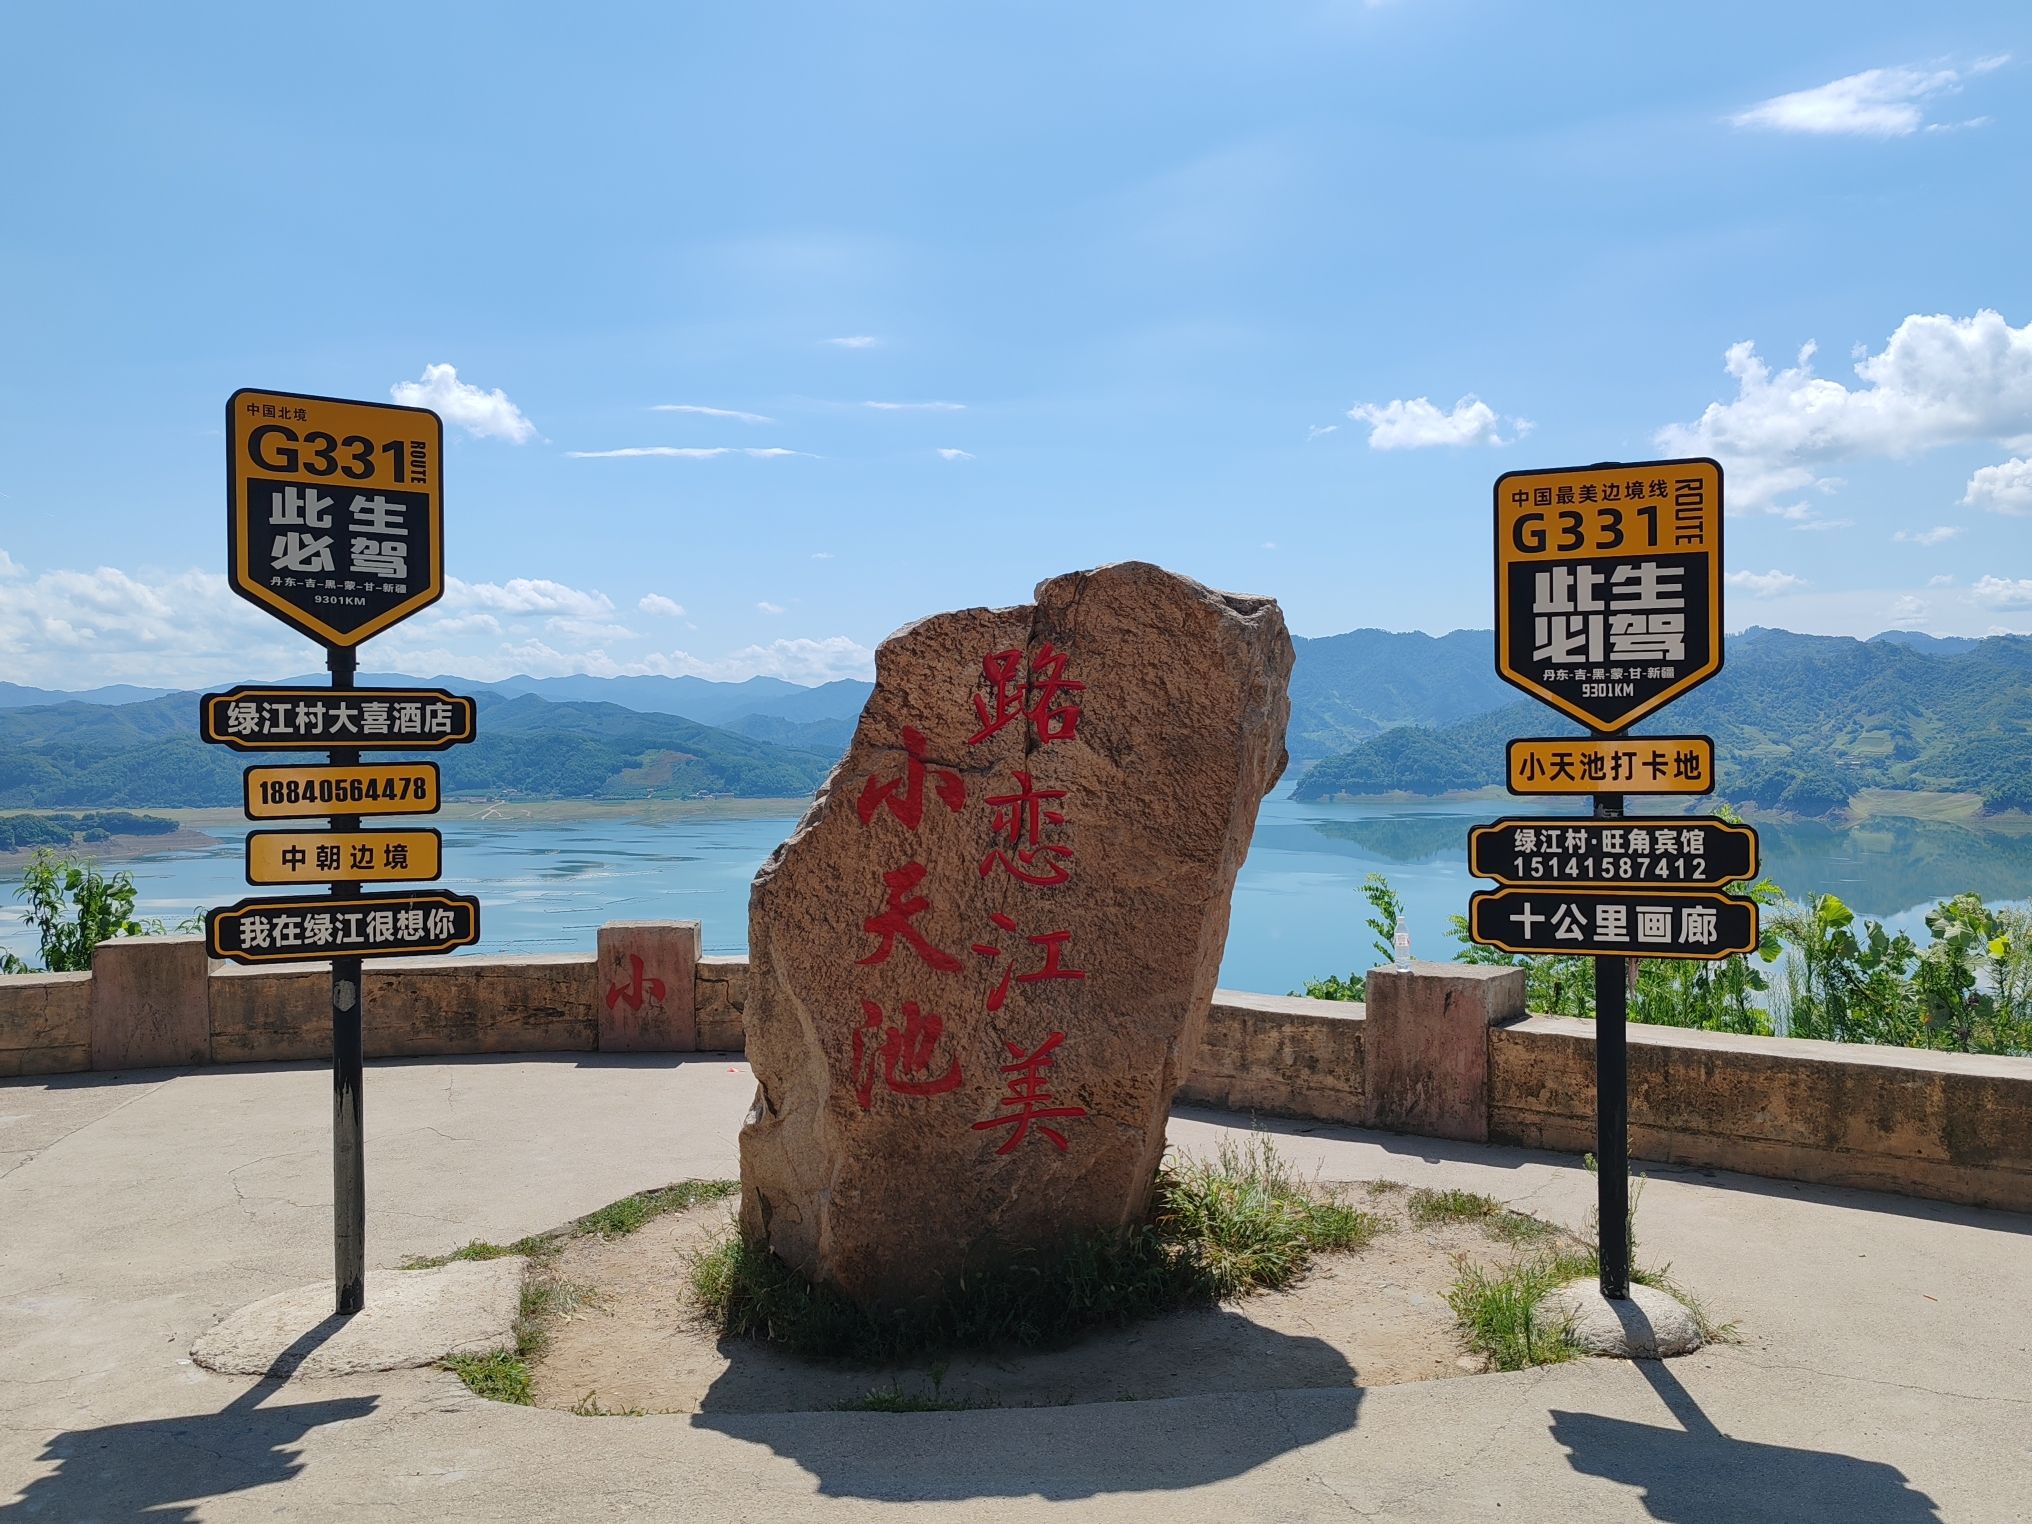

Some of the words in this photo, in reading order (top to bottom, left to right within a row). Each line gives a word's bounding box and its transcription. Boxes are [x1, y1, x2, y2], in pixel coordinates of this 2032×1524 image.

[247, 403, 307, 421] 中国北境
[247, 425, 405, 483] G331
[410, 441, 426, 484] ROUTE
[269, 486, 408, 535] 此生
[1512, 479, 1668, 508] 中国最美边境线
[1675, 478, 1703, 545] ROUTE
[1513, 506, 1658, 553] G331
[270, 532, 407, 578] 必驾
[315, 595, 366, 606] 9301KM
[1533, 562, 1684, 613] 此生
[1533, 614, 1684, 663] 必驾
[1582, 683, 1634, 697] 9301KM
[227, 702, 453, 735] 绿江村大喜酒店
[1519, 750, 1702, 782] 小天池打卡地
[260, 777, 427, 805] 18840564478
[281, 843, 409, 872] 中朝边境
[1513, 828, 1705, 855] 绿江村·旺角宾馆
[1513, 857, 1706, 879] 15141587412
[856, 726, 967, 1109] 小天池
[969, 642, 1087, 1156] 路恋江美
[240, 908, 455, 949] 我在绿江很想你
[1509, 902, 1718, 945] 十公里画廊
[606, 953, 666, 1011] 小
